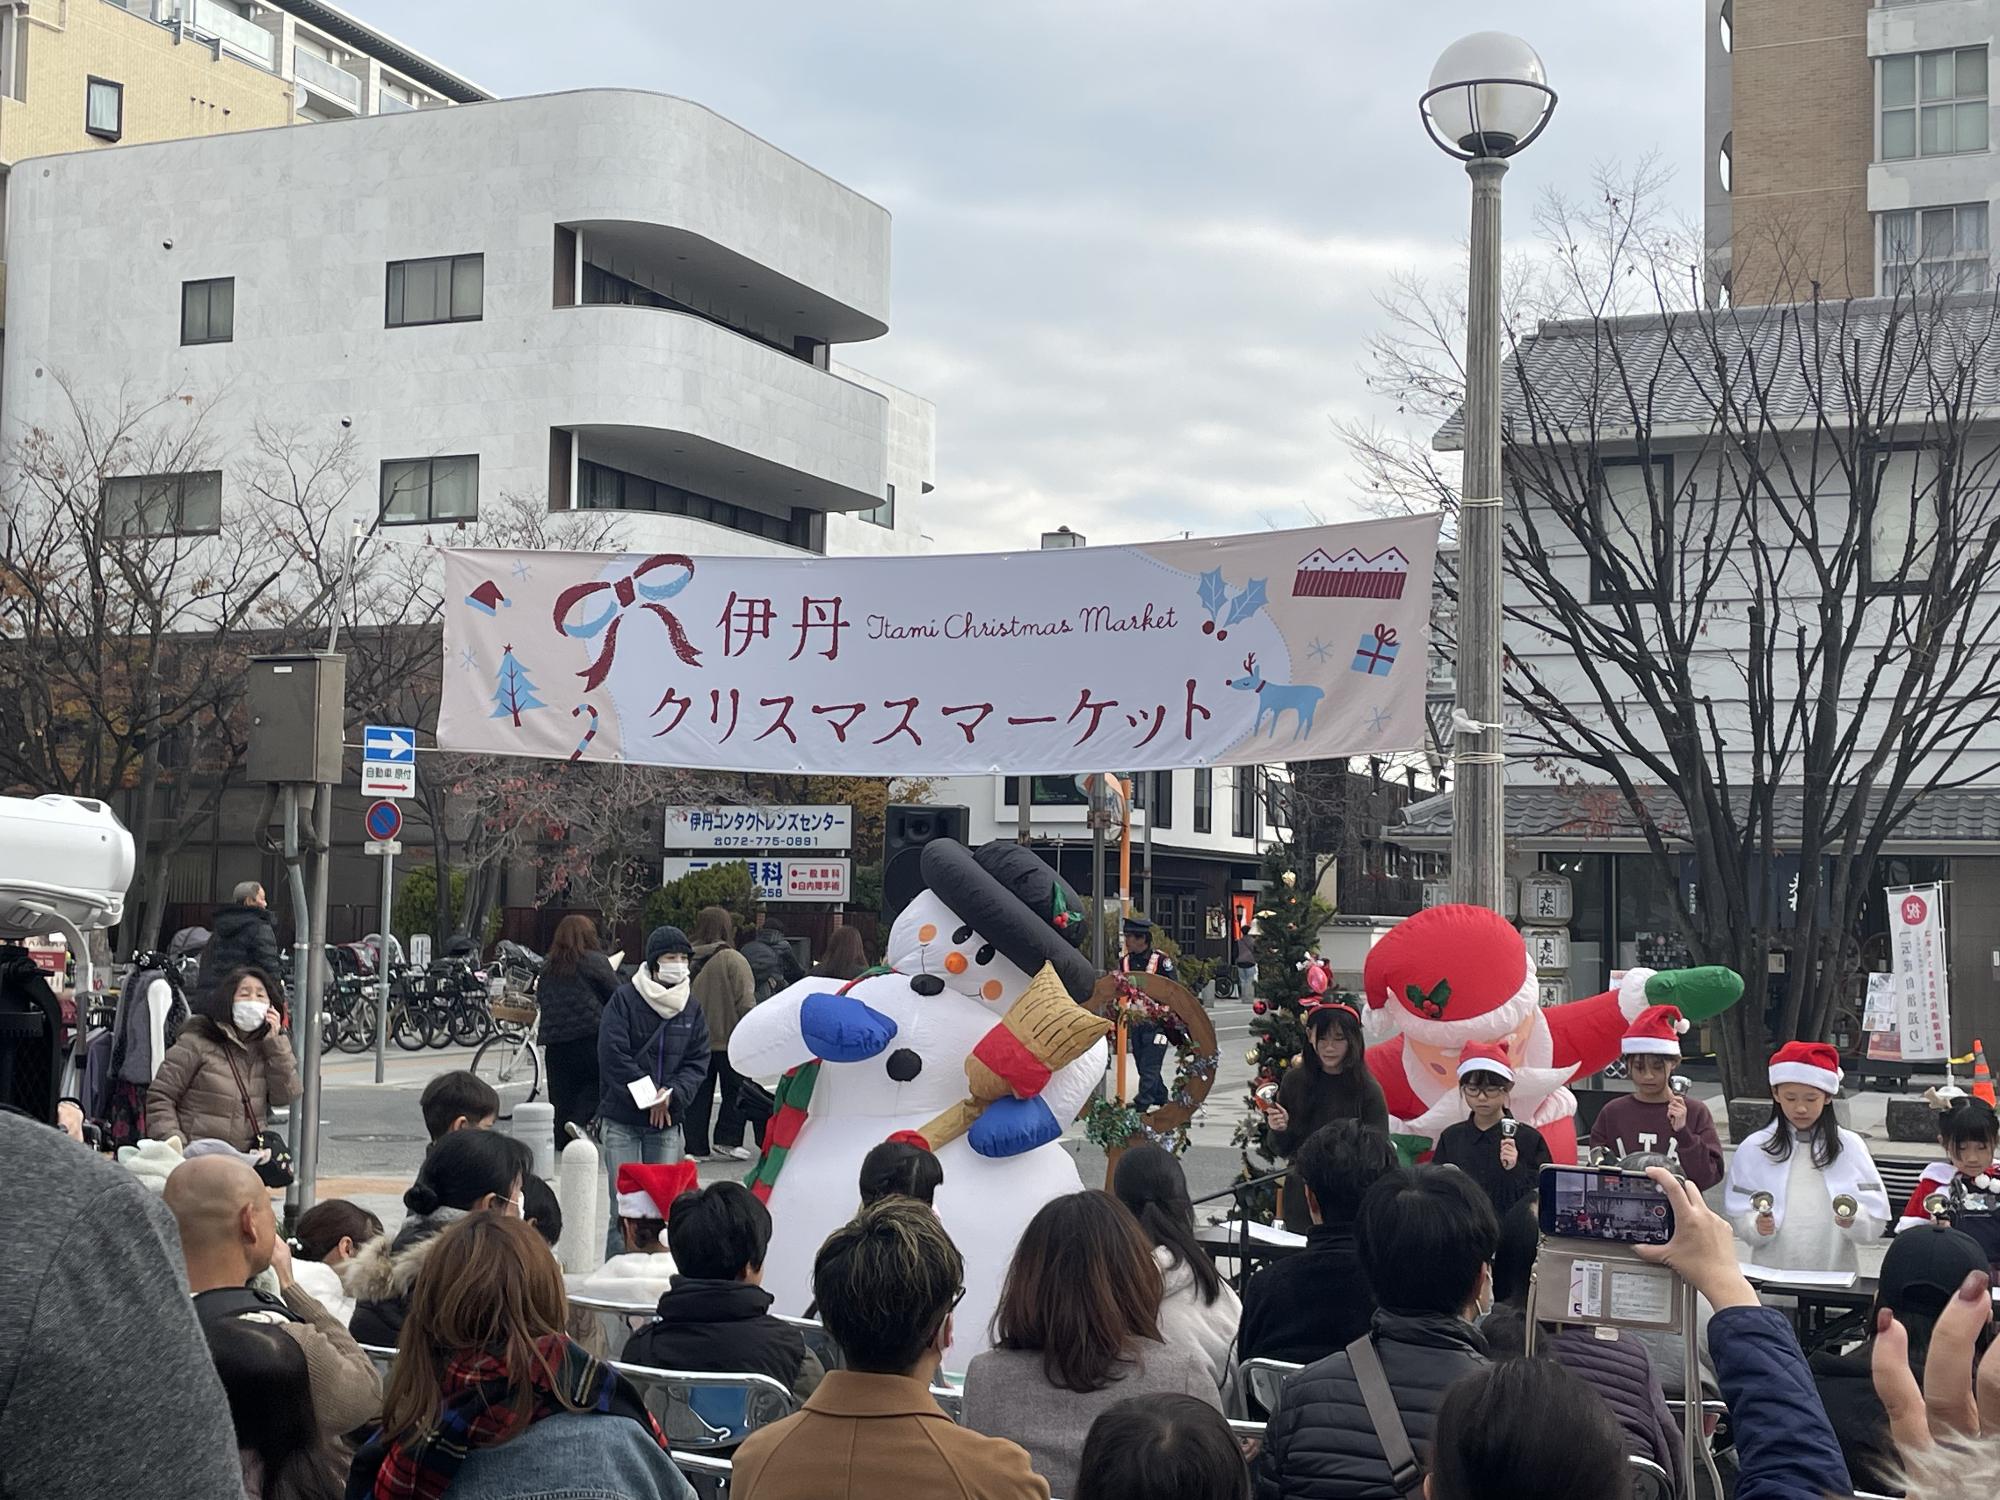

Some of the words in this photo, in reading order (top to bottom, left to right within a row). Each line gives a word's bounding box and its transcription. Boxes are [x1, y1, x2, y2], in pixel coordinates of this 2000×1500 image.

[716, 590, 851, 661] 伊丹
[867, 614, 939, 639] Itami
[944, 612, 1073, 640] Christmas
[1079, 602, 1178, 633] Market
[650, 678, 1210, 749] クリスマスマーケット
[690, 812, 845, 832] 伊丹コンタクトレンズセンター
